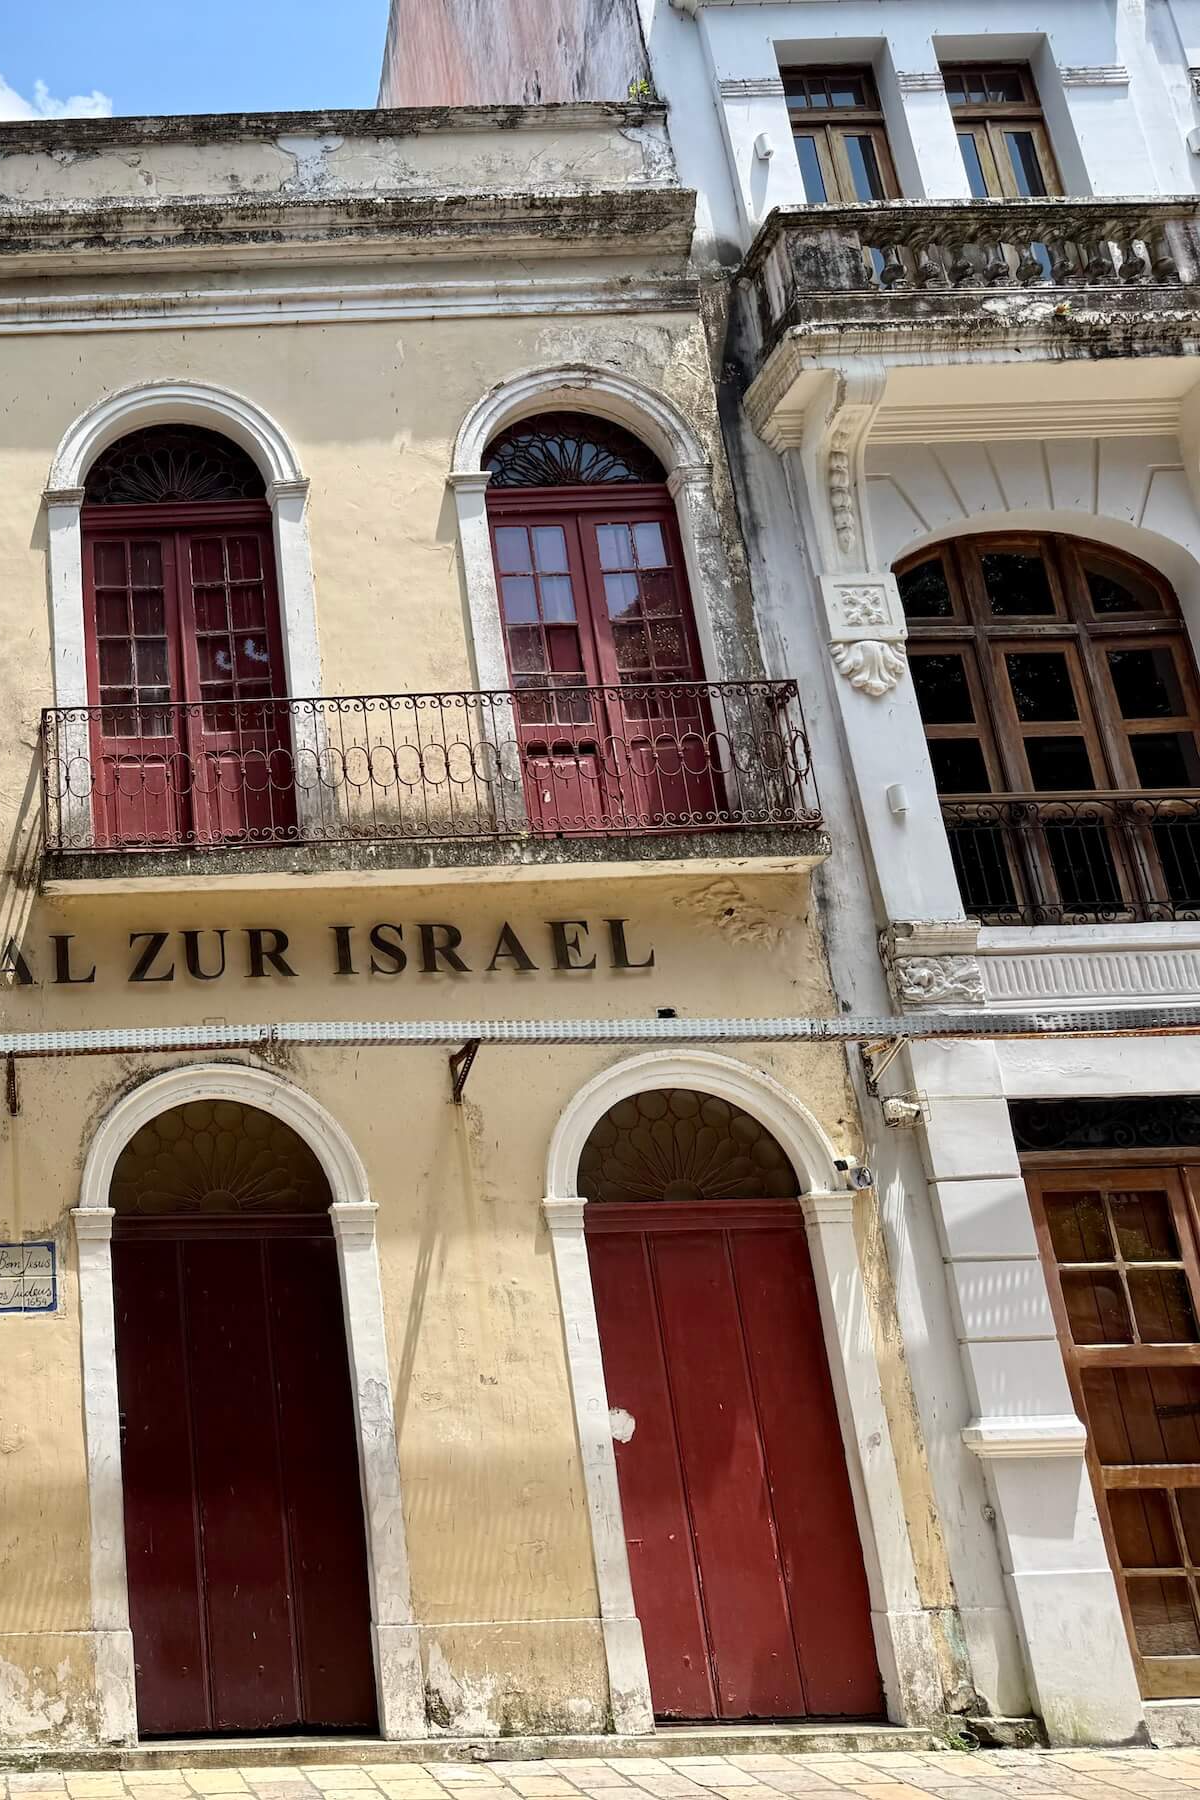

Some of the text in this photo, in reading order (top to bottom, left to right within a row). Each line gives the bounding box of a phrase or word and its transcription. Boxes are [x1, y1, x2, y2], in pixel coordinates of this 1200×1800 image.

[127, 927, 300, 983] ZUR
[327, 918, 655, 976] ISRAEL
[10, 1251, 51, 1275] Jesus
